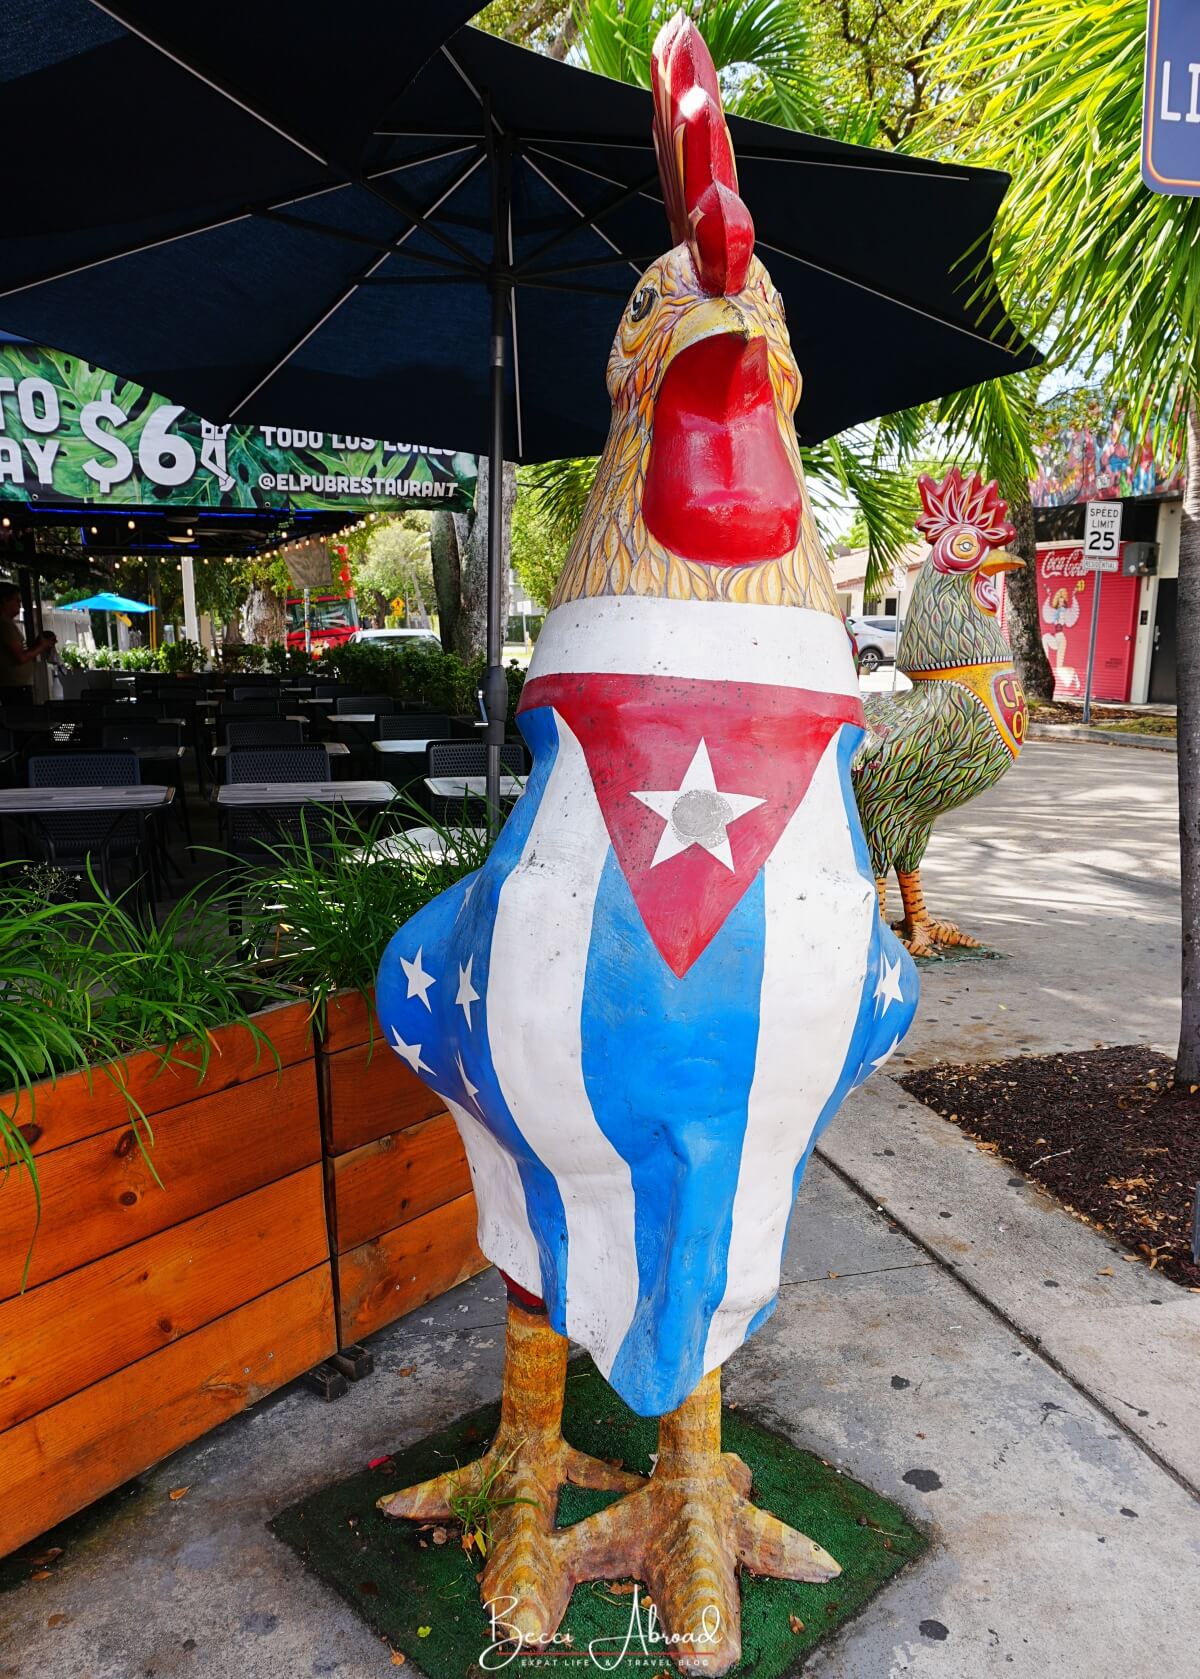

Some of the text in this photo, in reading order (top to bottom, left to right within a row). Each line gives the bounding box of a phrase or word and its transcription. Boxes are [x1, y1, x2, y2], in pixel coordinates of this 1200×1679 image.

[79, 389, 197, 493] $6
[260, 425, 323, 449] TODO
[258, 473, 458, 498] @ELPUBRESTAURANT
[1090, 508, 1119, 518] SPEED
[1092, 520, 1115, 529] LIMIT
[1089, 531, 1115, 551] 25
